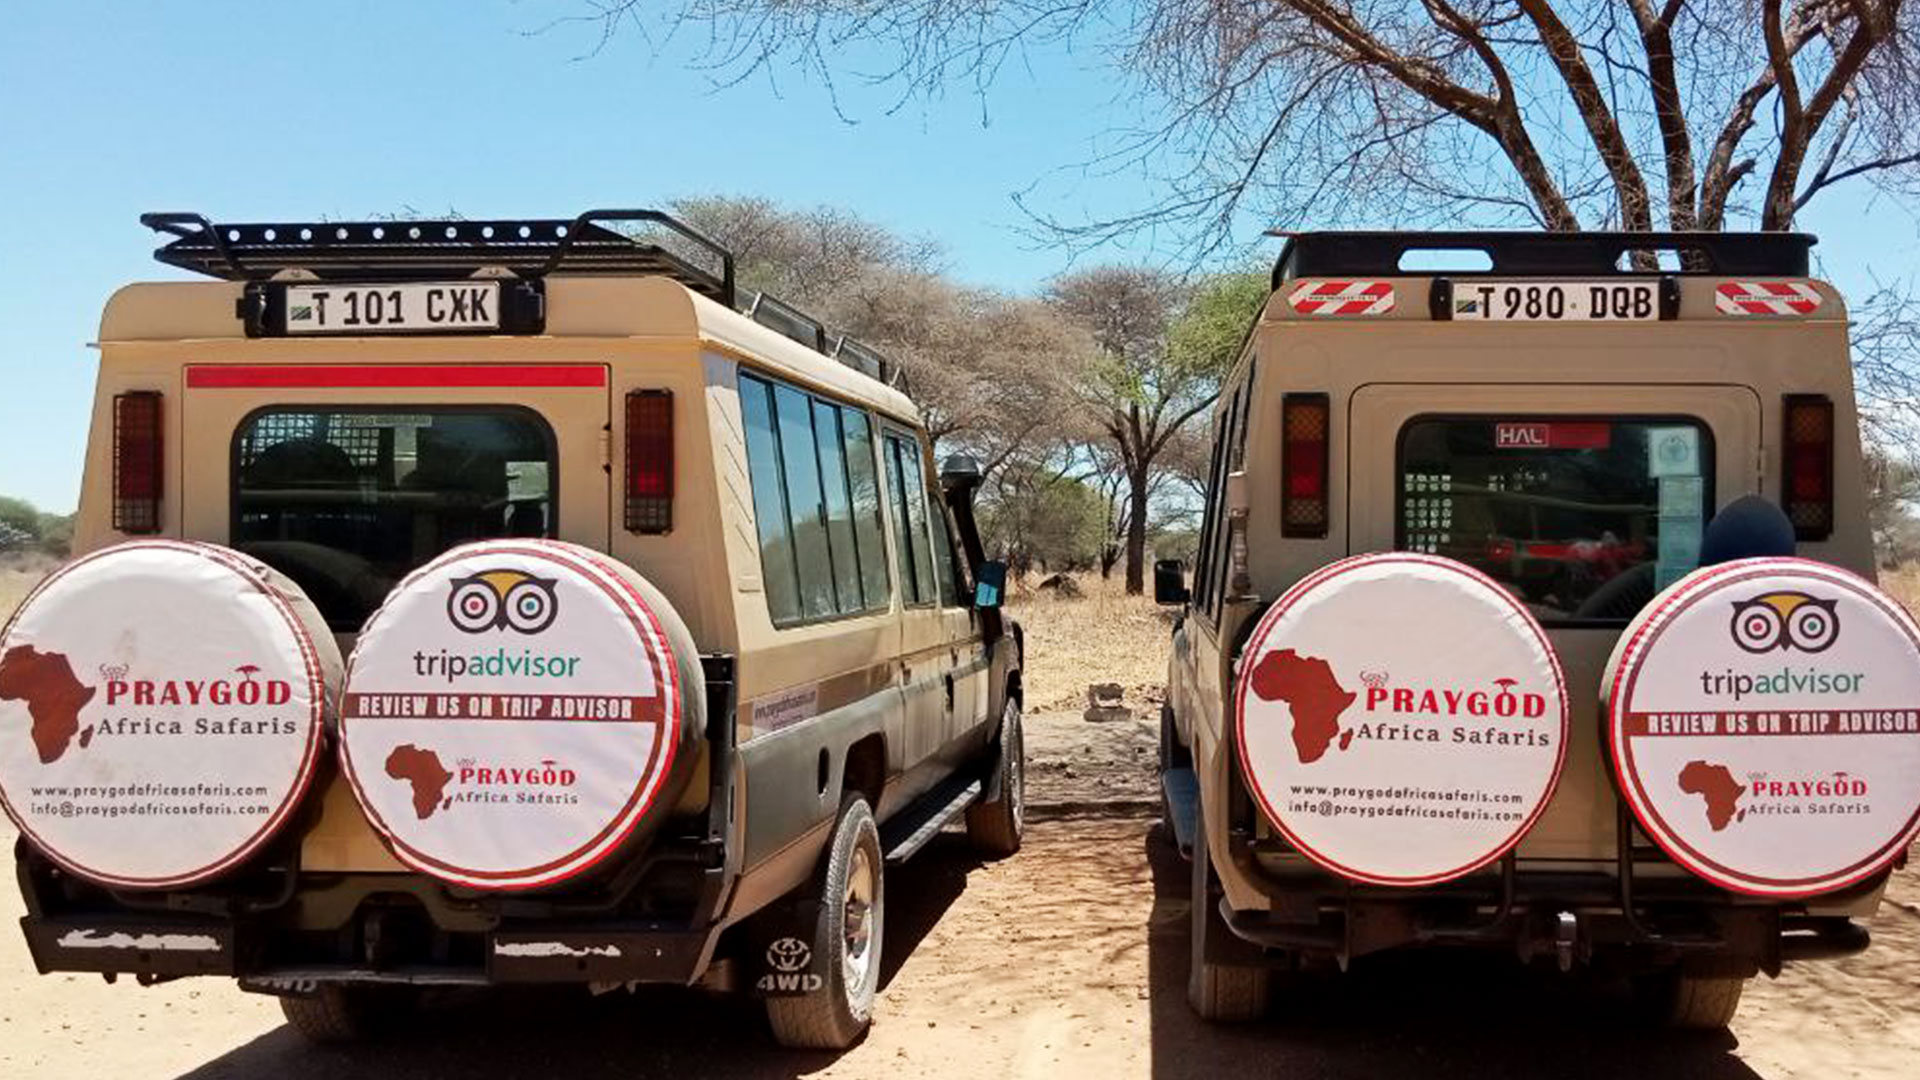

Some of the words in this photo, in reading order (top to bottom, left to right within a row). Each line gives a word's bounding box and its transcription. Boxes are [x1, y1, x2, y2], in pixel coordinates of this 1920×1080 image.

[312, 292, 330, 325] T
[344, 290, 404, 325] 101
[426, 288, 489, 323] CXK
[1477, 286, 1495, 319] T
[1504, 286, 1564, 319] 980
[1589, 286, 1651, 319] DQB
[413, 648, 581, 683] tripadvisor
[106, 679, 292, 706] PRAYGOD
[1700, 667, 1865, 701] tripadvisor
[358, 696, 429, 717] REVIEW
[436, 696, 460, 717] US
[468, 696, 493, 717] ON
[501, 697, 542, 718] TRIP
[551, 698, 632, 719] ADVISOR
[1366, 687, 1546, 719] PRAYGOD
[97, 717, 183, 735] Africa
[194, 717, 297, 735] Safaris
[1648, 714, 1717, 734] REVIEW
[1725, 714, 1749, 733] US
[1756, 713, 1781, 733] ON
[1789, 713, 1830, 733] TRIP
[1838, 711, 1919, 732] ADVISOR
[1356, 723, 1440, 742] Africa
[1451, 727, 1550, 746] Safaris
[459, 768, 577, 787] PRAYGOD
[31, 783, 268, 799] www.praygodafricasafaris.com
[455, 791, 509, 803] Africa
[516, 792, 578, 805] Safaris
[1290, 785, 1523, 804] www.praygodafricasafaris.com
[1752, 780, 1868, 797] PRAYGOD
[31, 800, 271, 818] info@praygodafricasafaris.com
[1289, 801, 1523, 822] info@praygodafricasafaris.com
[1748, 803, 1801, 815] Africa
[1808, 803, 1871, 815] Safaris
[756, 973, 823, 991] 4WD
